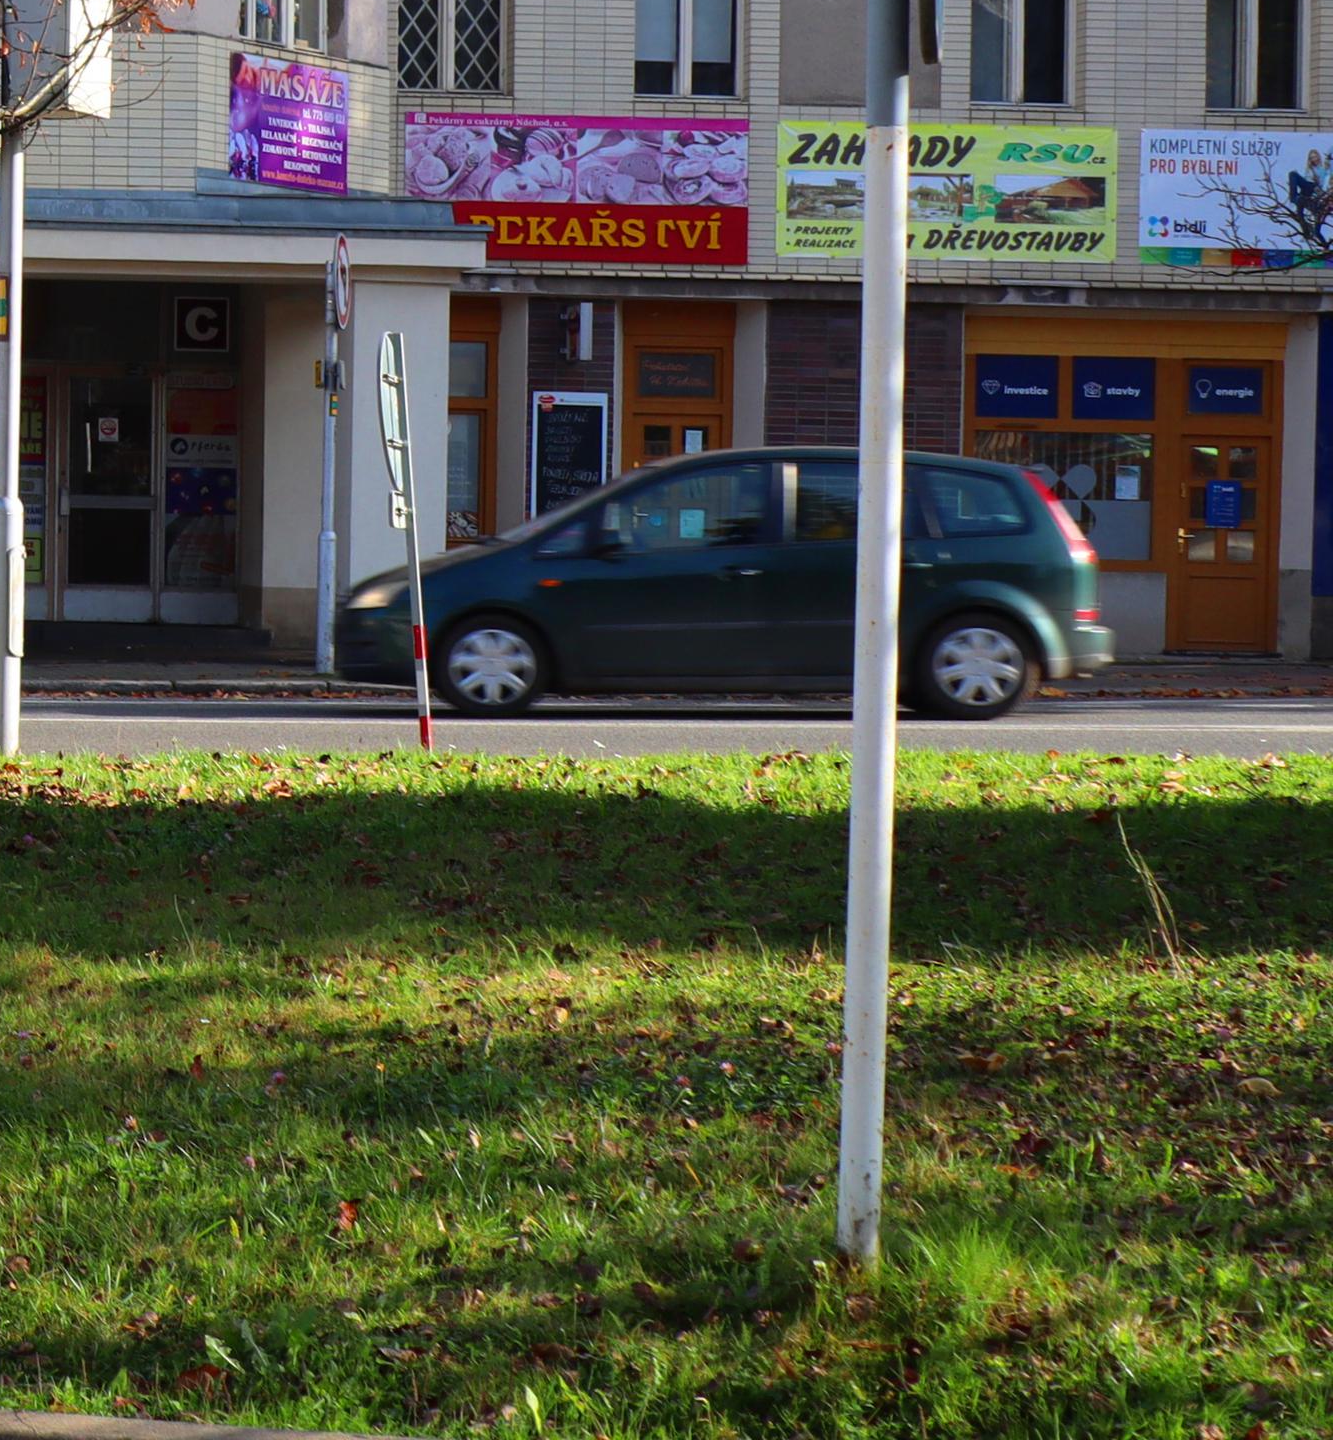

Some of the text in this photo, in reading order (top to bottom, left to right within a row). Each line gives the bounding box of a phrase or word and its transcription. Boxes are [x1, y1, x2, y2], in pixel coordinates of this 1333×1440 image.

[260, 69, 343, 109] MASÁŽE
[429, 116, 464, 126] Pekárny
[474, 117, 513, 127] cukrárny
[516, 118, 552, 128] Náchod,
[787, 133, 977, 168] ZAHADY
[1149, 135, 1282, 157] KOMPLETNÍ SLUŽBY
[1149, 158, 1176, 174] PRO
[793, 225, 854, 236] PROJEKTY
[793, 238, 856, 250] REALIZACE
[923, 223, 1105, 253] DŘEVOSTAVBY
[185, 306, 219, 341] C
[1004, 384, 1049, 396] investice
[1106, 385, 1141, 398] stavby
[1215, 387, 1254, 399] energie
